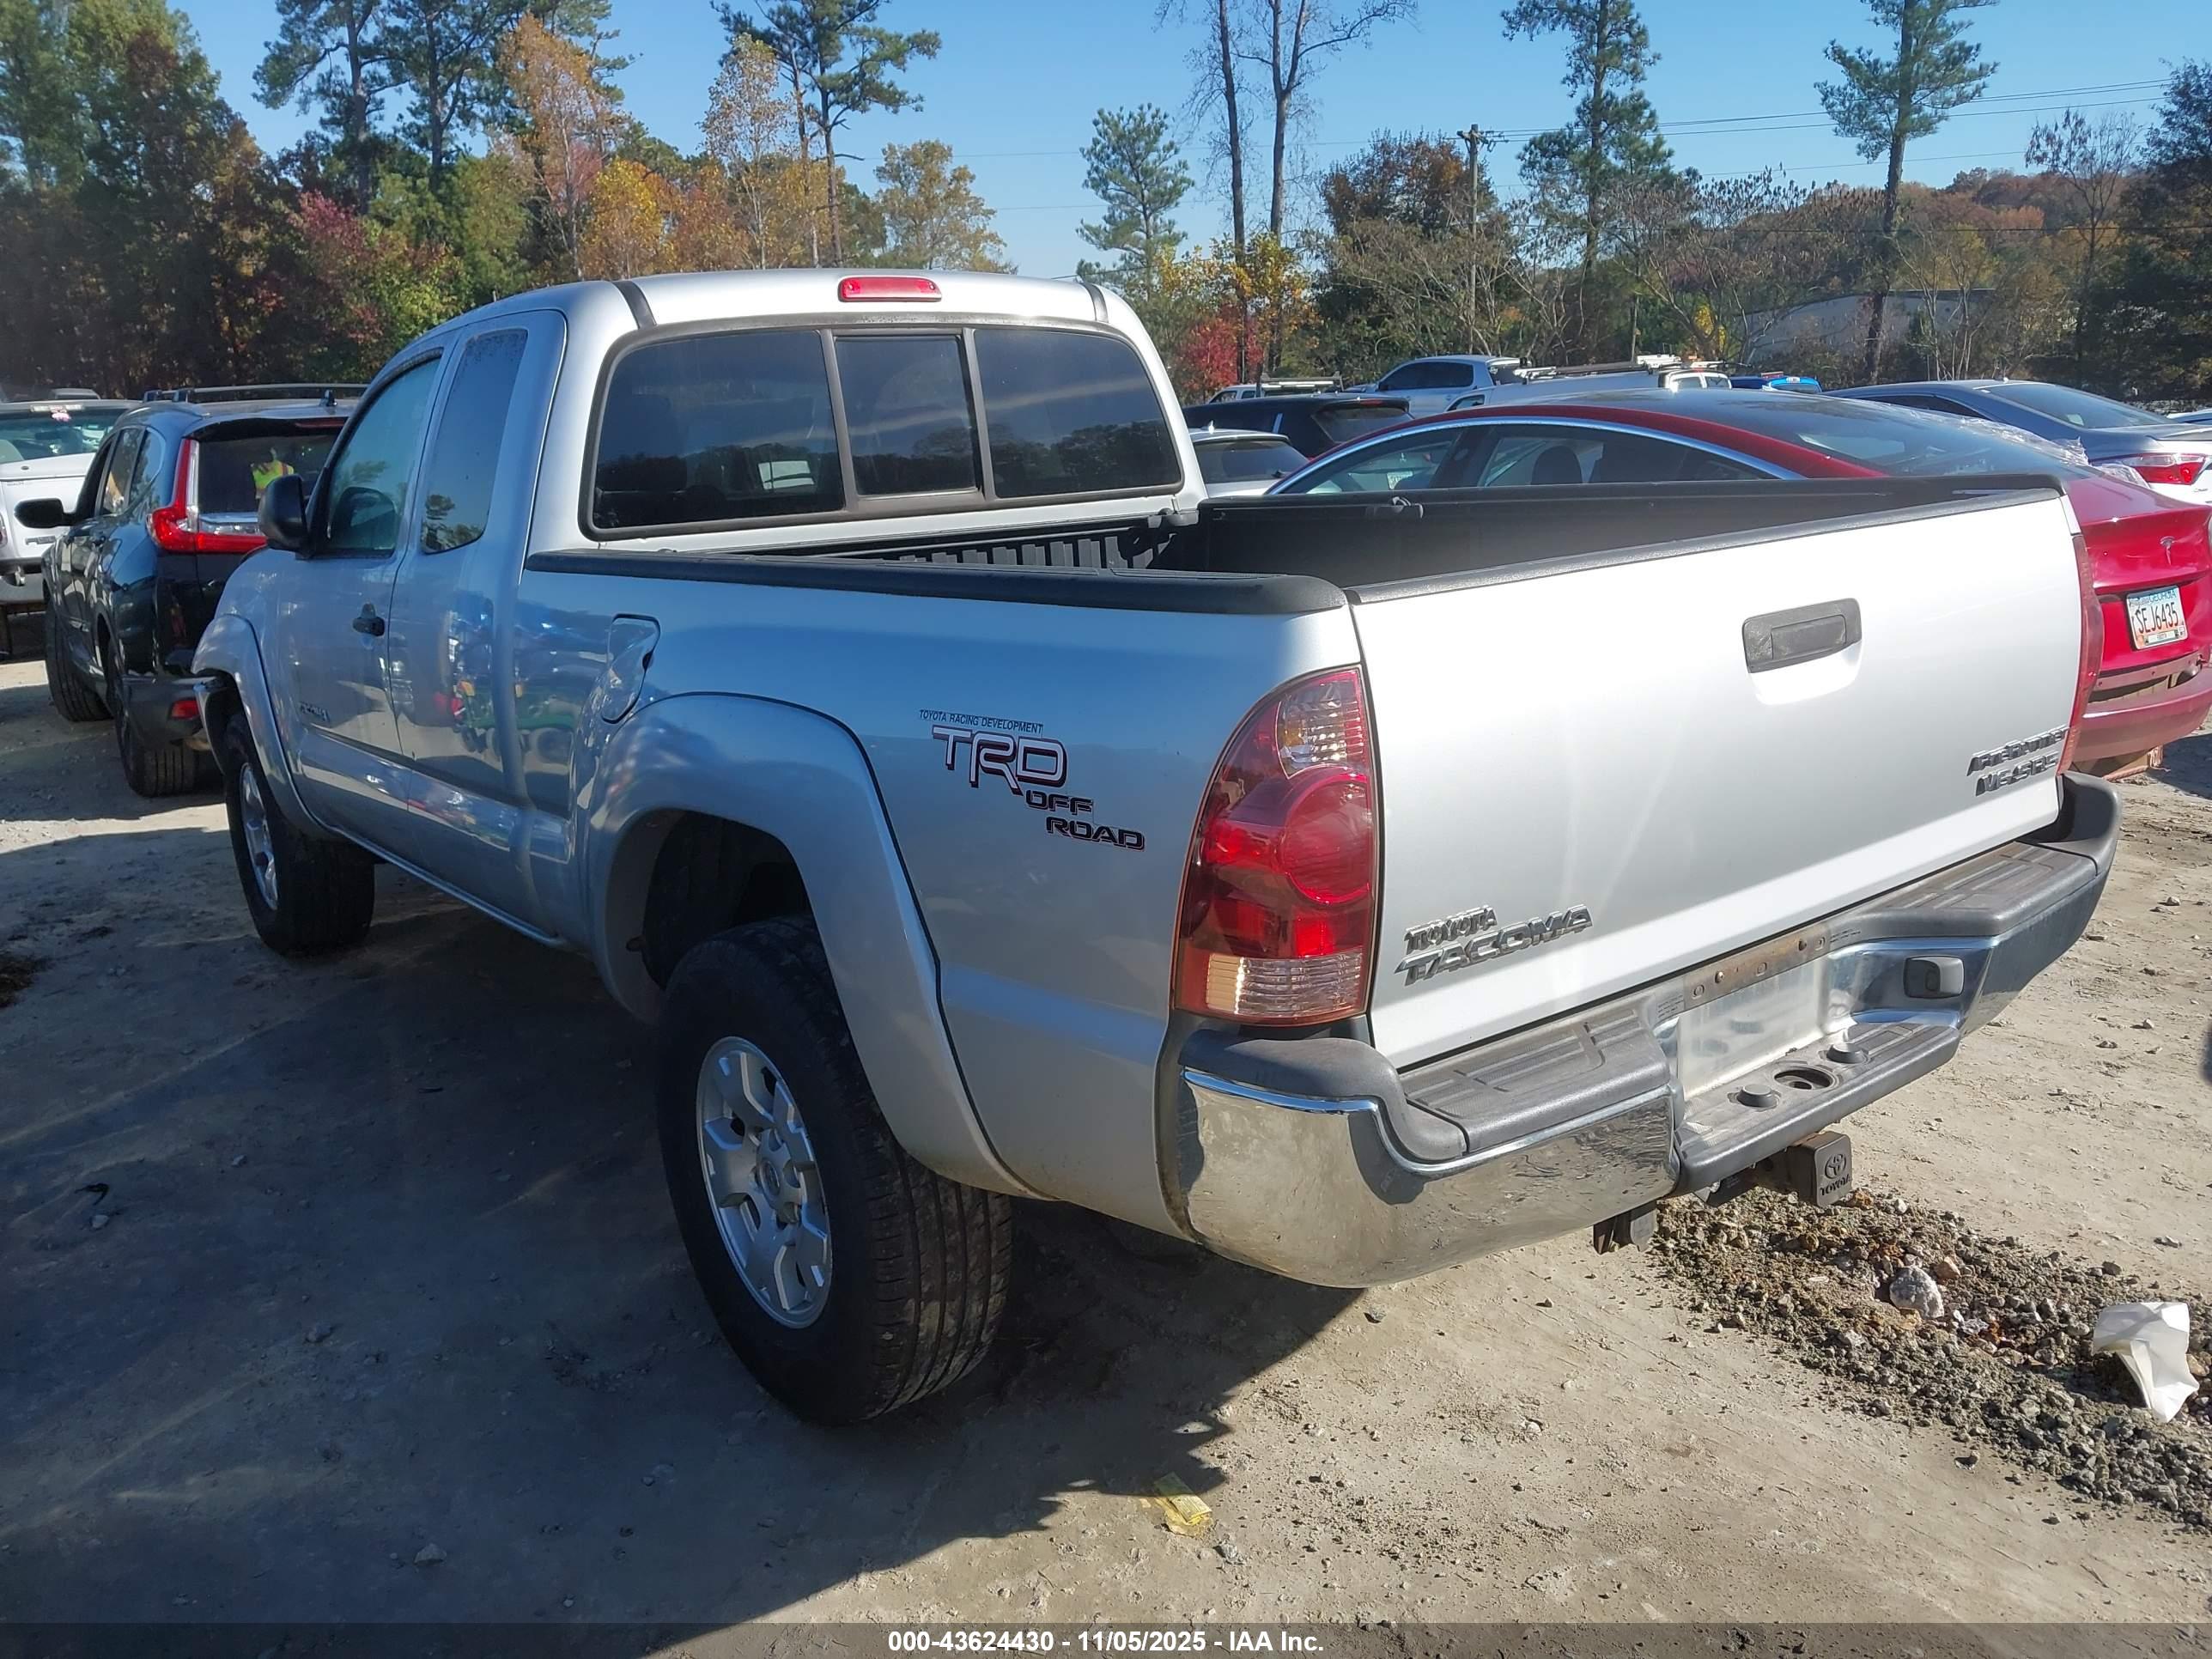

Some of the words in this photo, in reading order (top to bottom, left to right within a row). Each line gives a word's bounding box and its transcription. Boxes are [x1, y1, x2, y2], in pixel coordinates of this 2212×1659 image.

[2135, 602, 2179, 634] SEJ6435
[919, 709, 947, 722] TOYOTA
[949, 713, 979, 726] RACING
[981, 717, 1043, 734] DEVELOPMENT
[932, 725, 1068, 796] TRD
[1025, 789, 1093, 816] OFF
[1046, 816, 1146, 851] ROAD
[1394, 903, 1593, 986] TACOMA
[1404, 904, 1498, 955] TOYOTA
